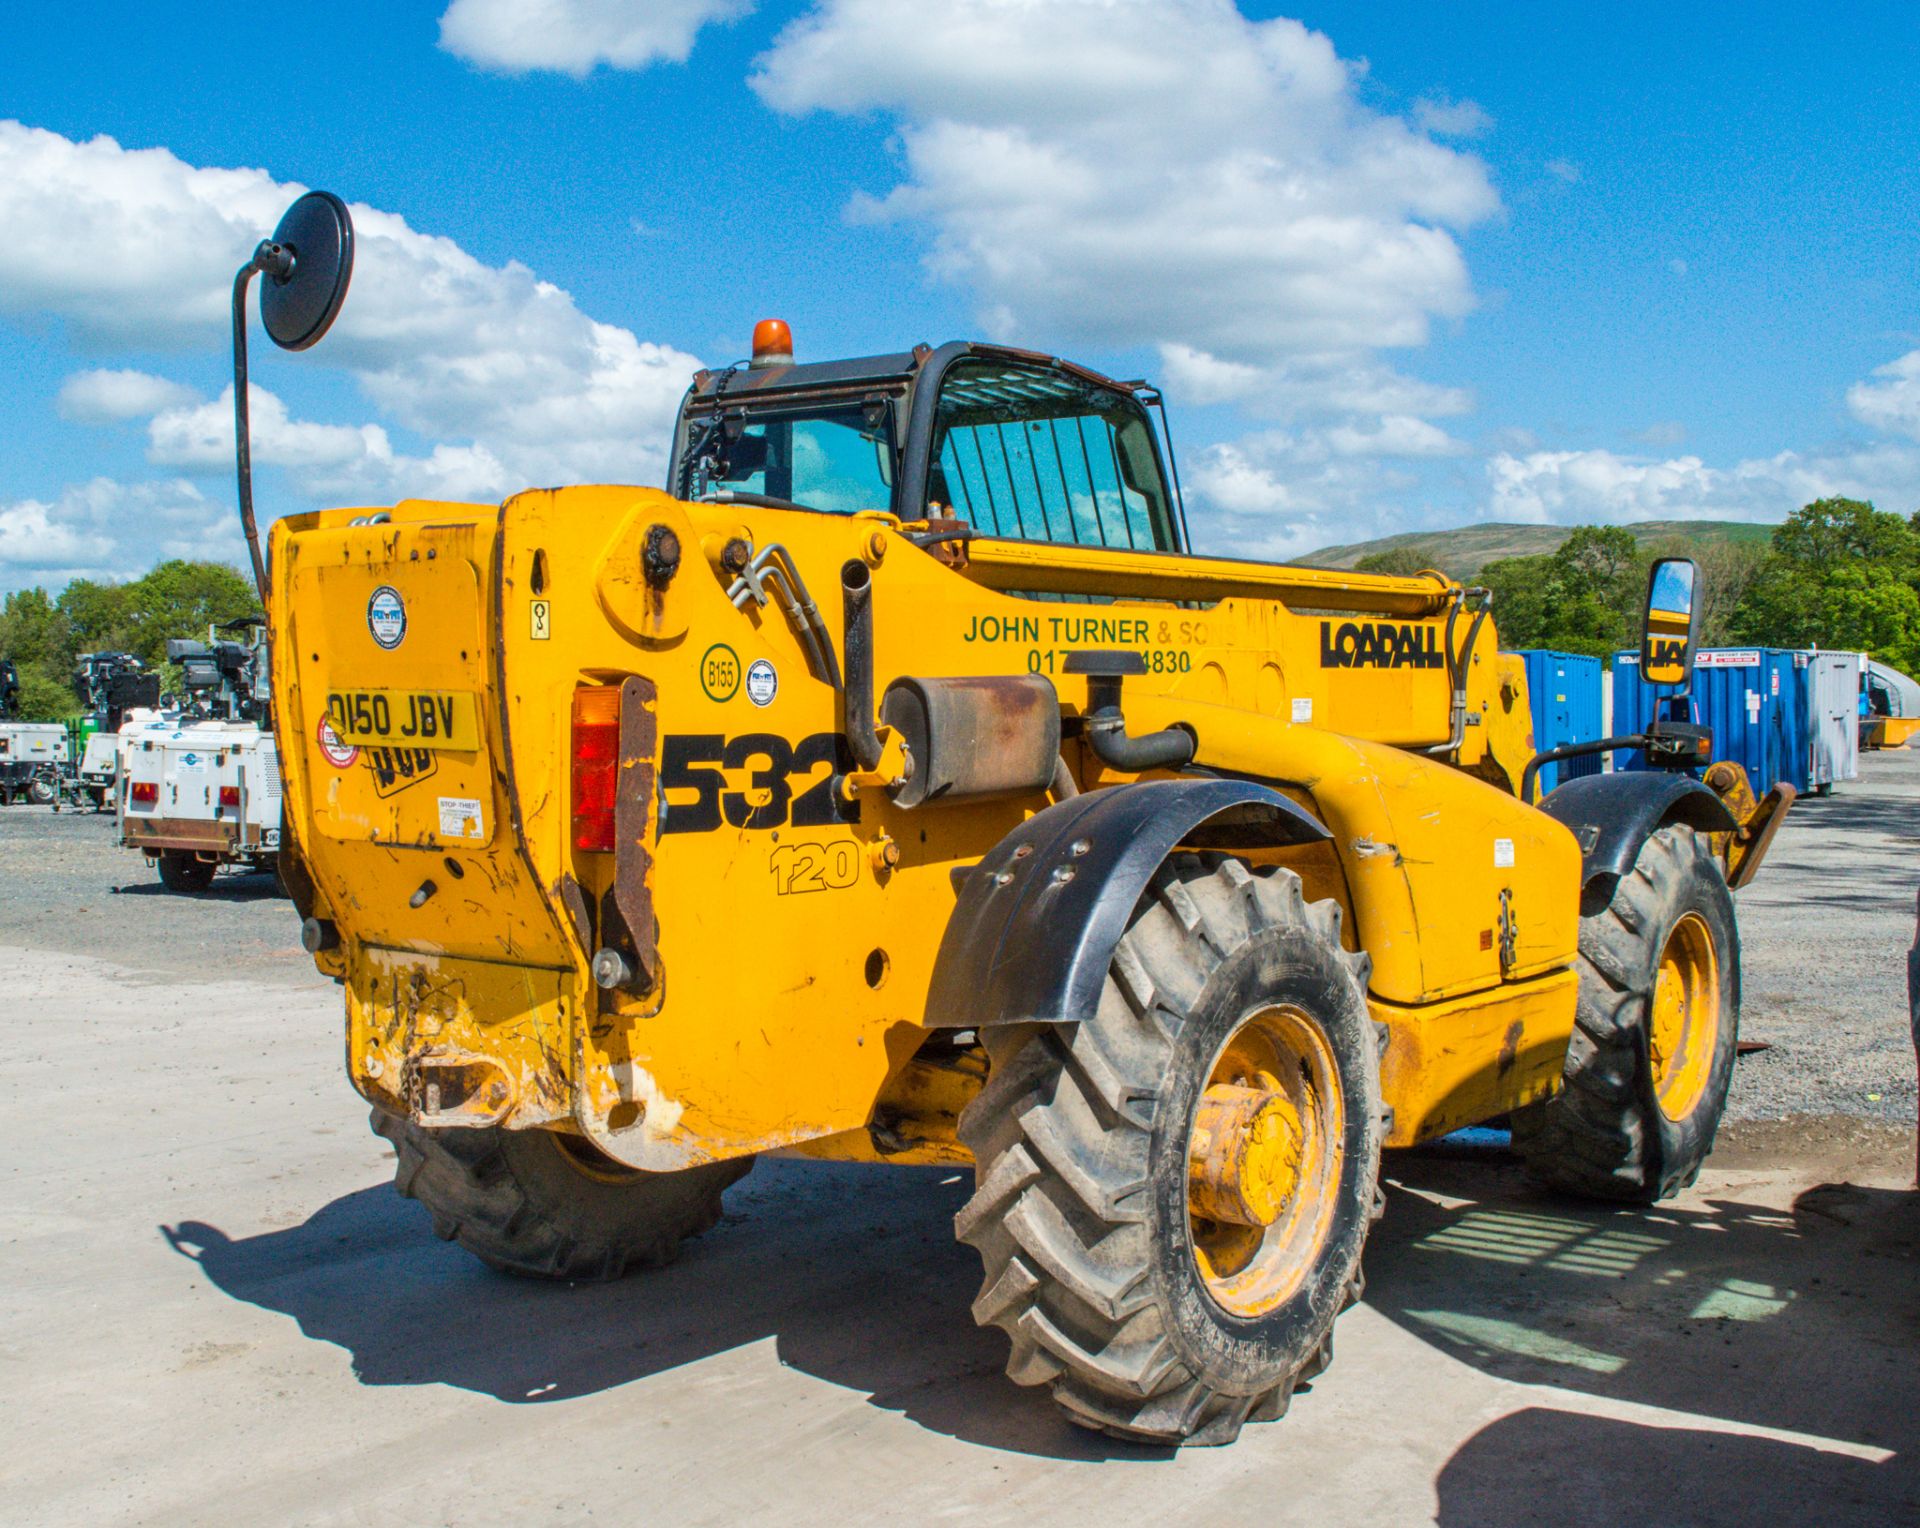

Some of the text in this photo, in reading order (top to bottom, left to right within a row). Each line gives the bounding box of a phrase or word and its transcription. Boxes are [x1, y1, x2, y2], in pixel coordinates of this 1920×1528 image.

[964, 616, 1039, 643] JOHN
[1048, 617, 1150, 644] TURNER
[1157, 620, 1172, 644] &
[1320, 621, 1444, 669] LOADALL
[708, 660, 734, 688] B155
[401, 695, 454, 739] JBV
[661, 732, 861, 835] 532
[770, 839, 860, 896] 120
